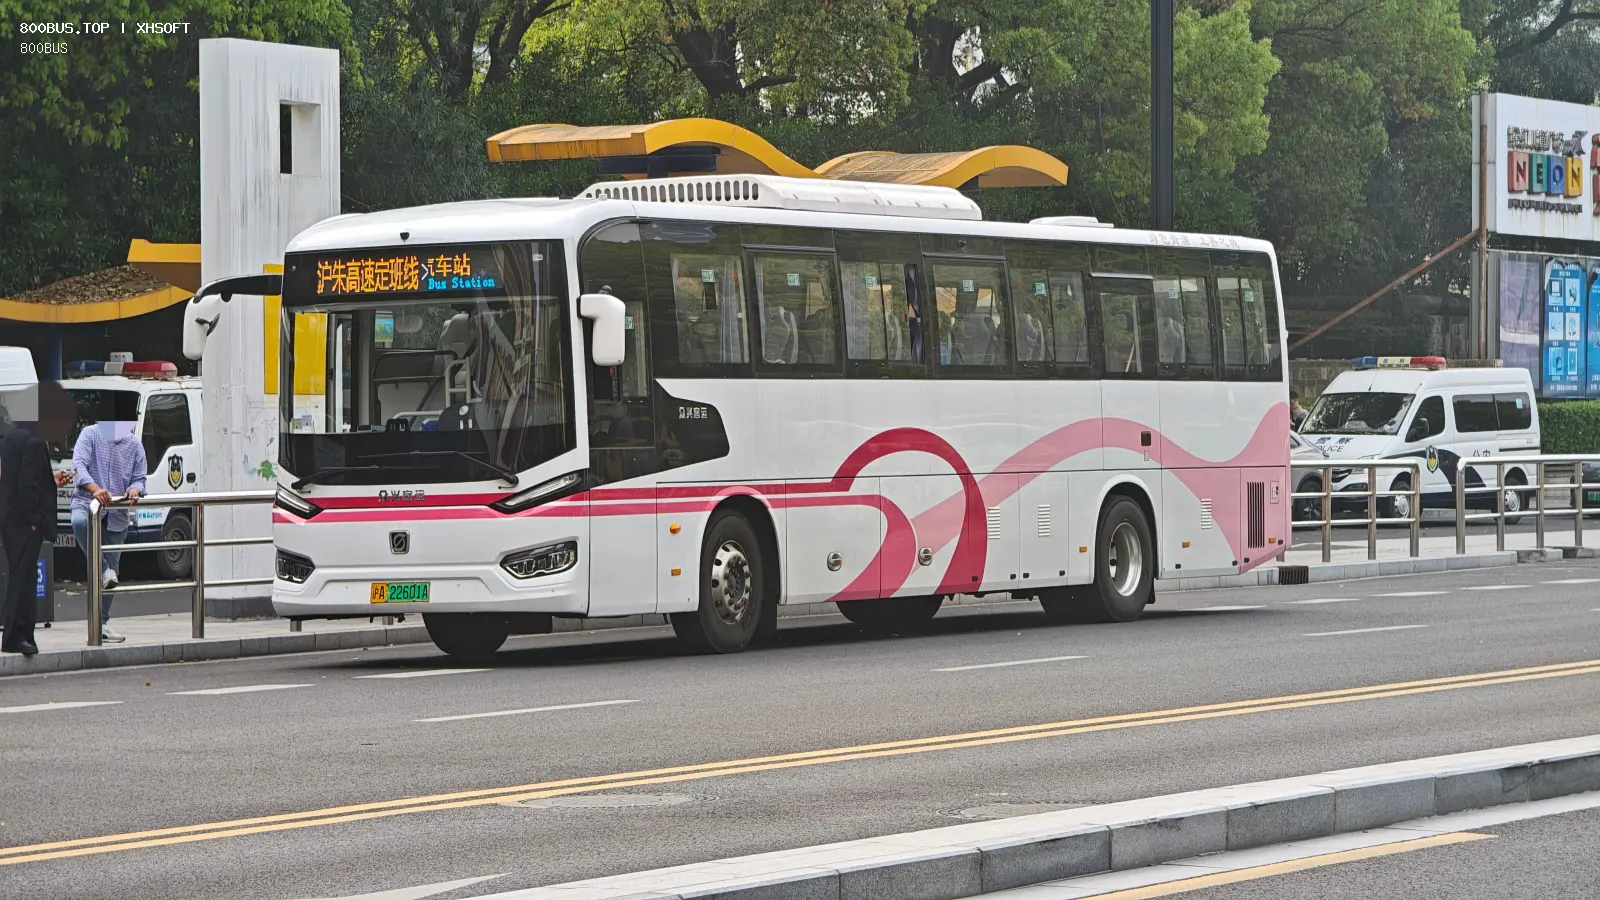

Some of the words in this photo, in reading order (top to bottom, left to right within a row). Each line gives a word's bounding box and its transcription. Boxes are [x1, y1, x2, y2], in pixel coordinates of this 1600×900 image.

[1514, 158, 1581, 190] NEON
[316, 255, 419, 294] 沪朱高速定班线
[428, 277, 447, 290] Bus
[451, 275, 496, 289] Station
